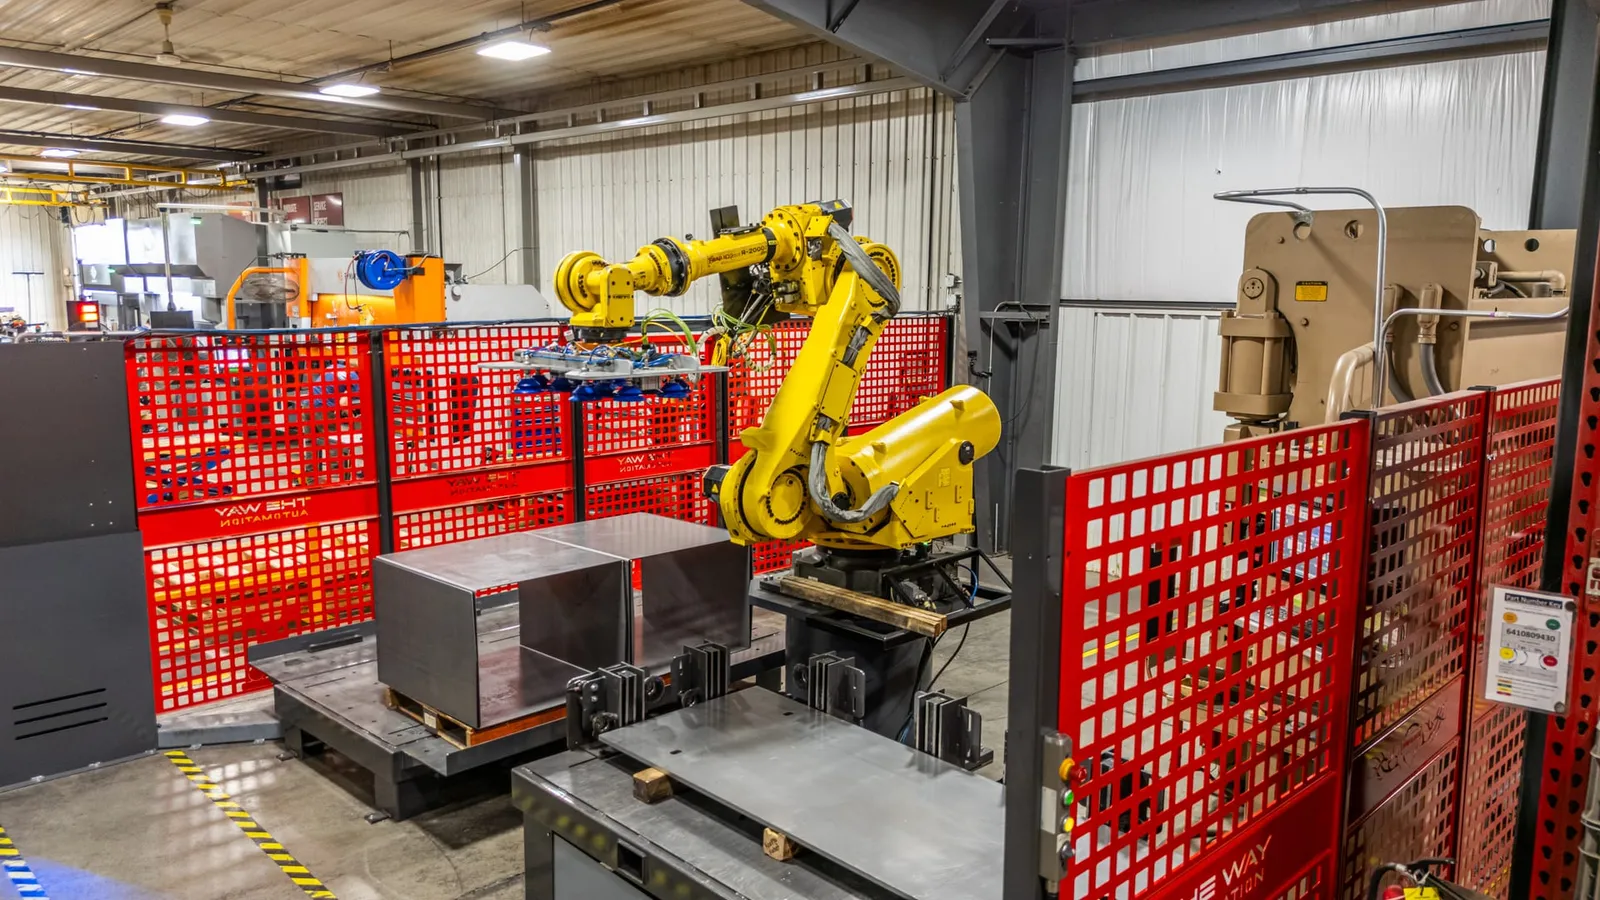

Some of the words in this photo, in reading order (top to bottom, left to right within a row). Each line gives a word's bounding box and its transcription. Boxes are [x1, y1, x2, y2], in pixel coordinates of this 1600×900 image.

[1506, 594, 1519, 603] Part
[1520, 597, 1548, 606] Number
[1549, 601, 1562, 609] Key
[1506, 628, 1556, 642] 6410809430
[1222, 834, 1272, 886] WAY
